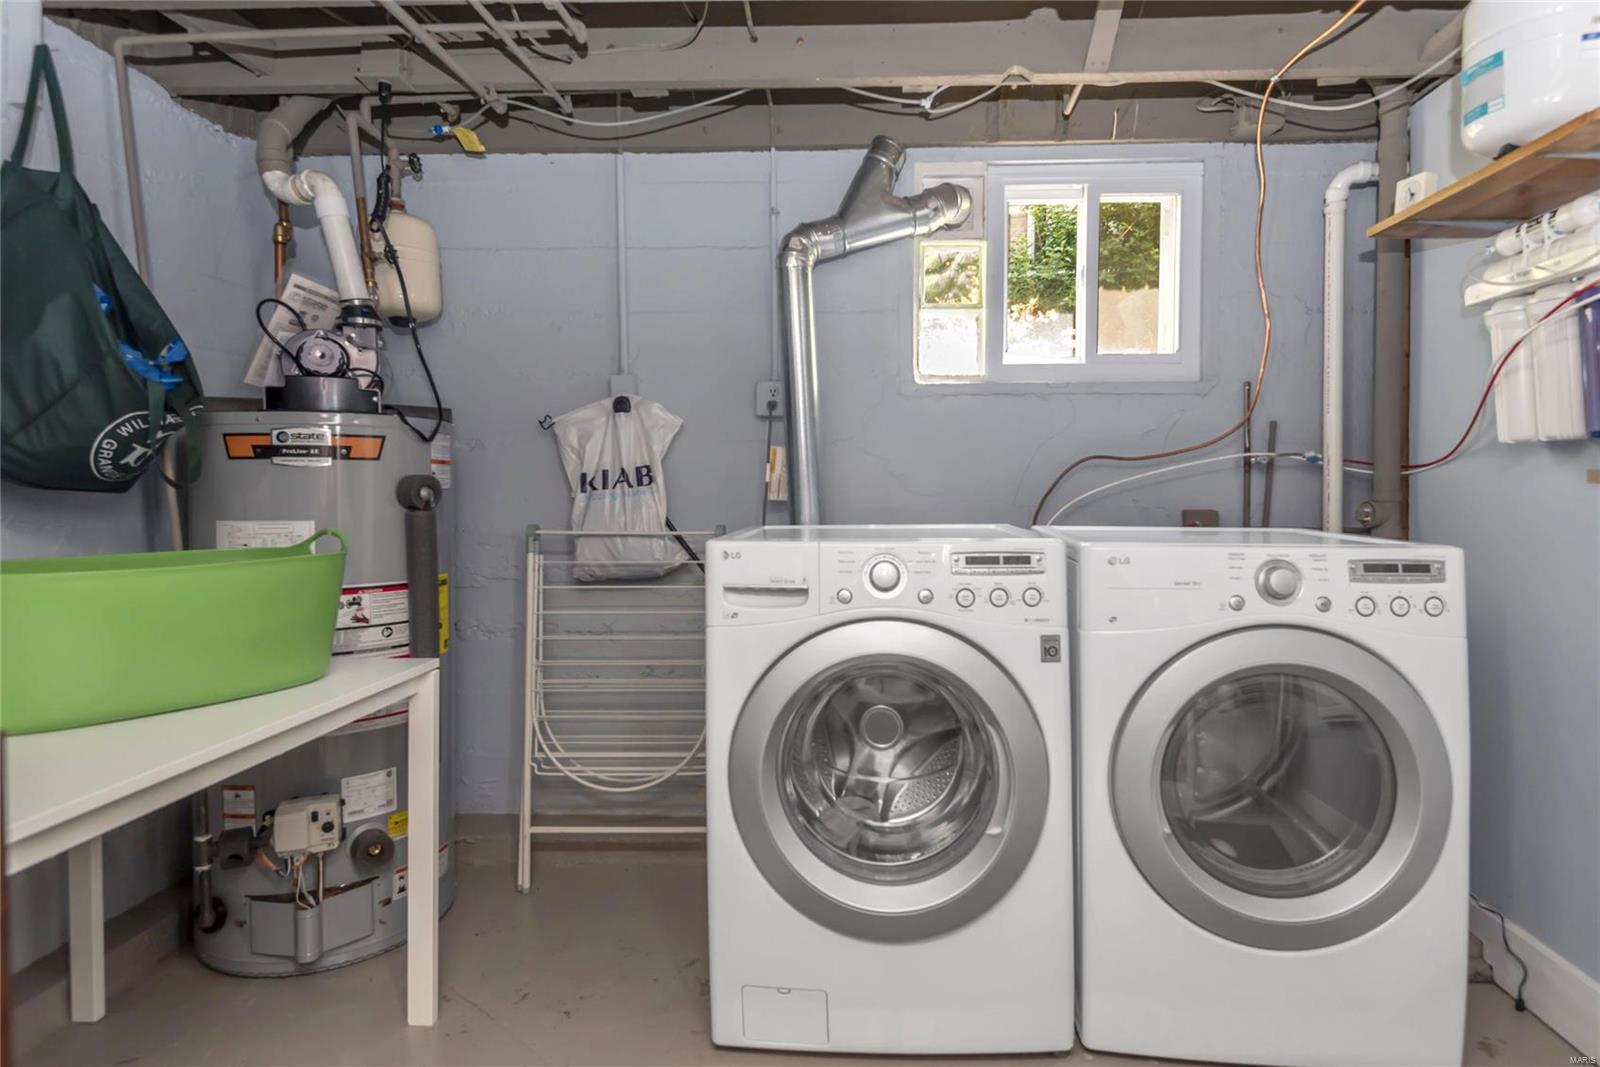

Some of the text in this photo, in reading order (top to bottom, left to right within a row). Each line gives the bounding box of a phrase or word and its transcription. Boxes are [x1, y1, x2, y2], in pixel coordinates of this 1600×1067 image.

[290, 432, 325, 441] state
[580, 465, 654, 493] KIAB
[730, 551, 742, 560] LG
[1118, 556, 1131, 565] LG
